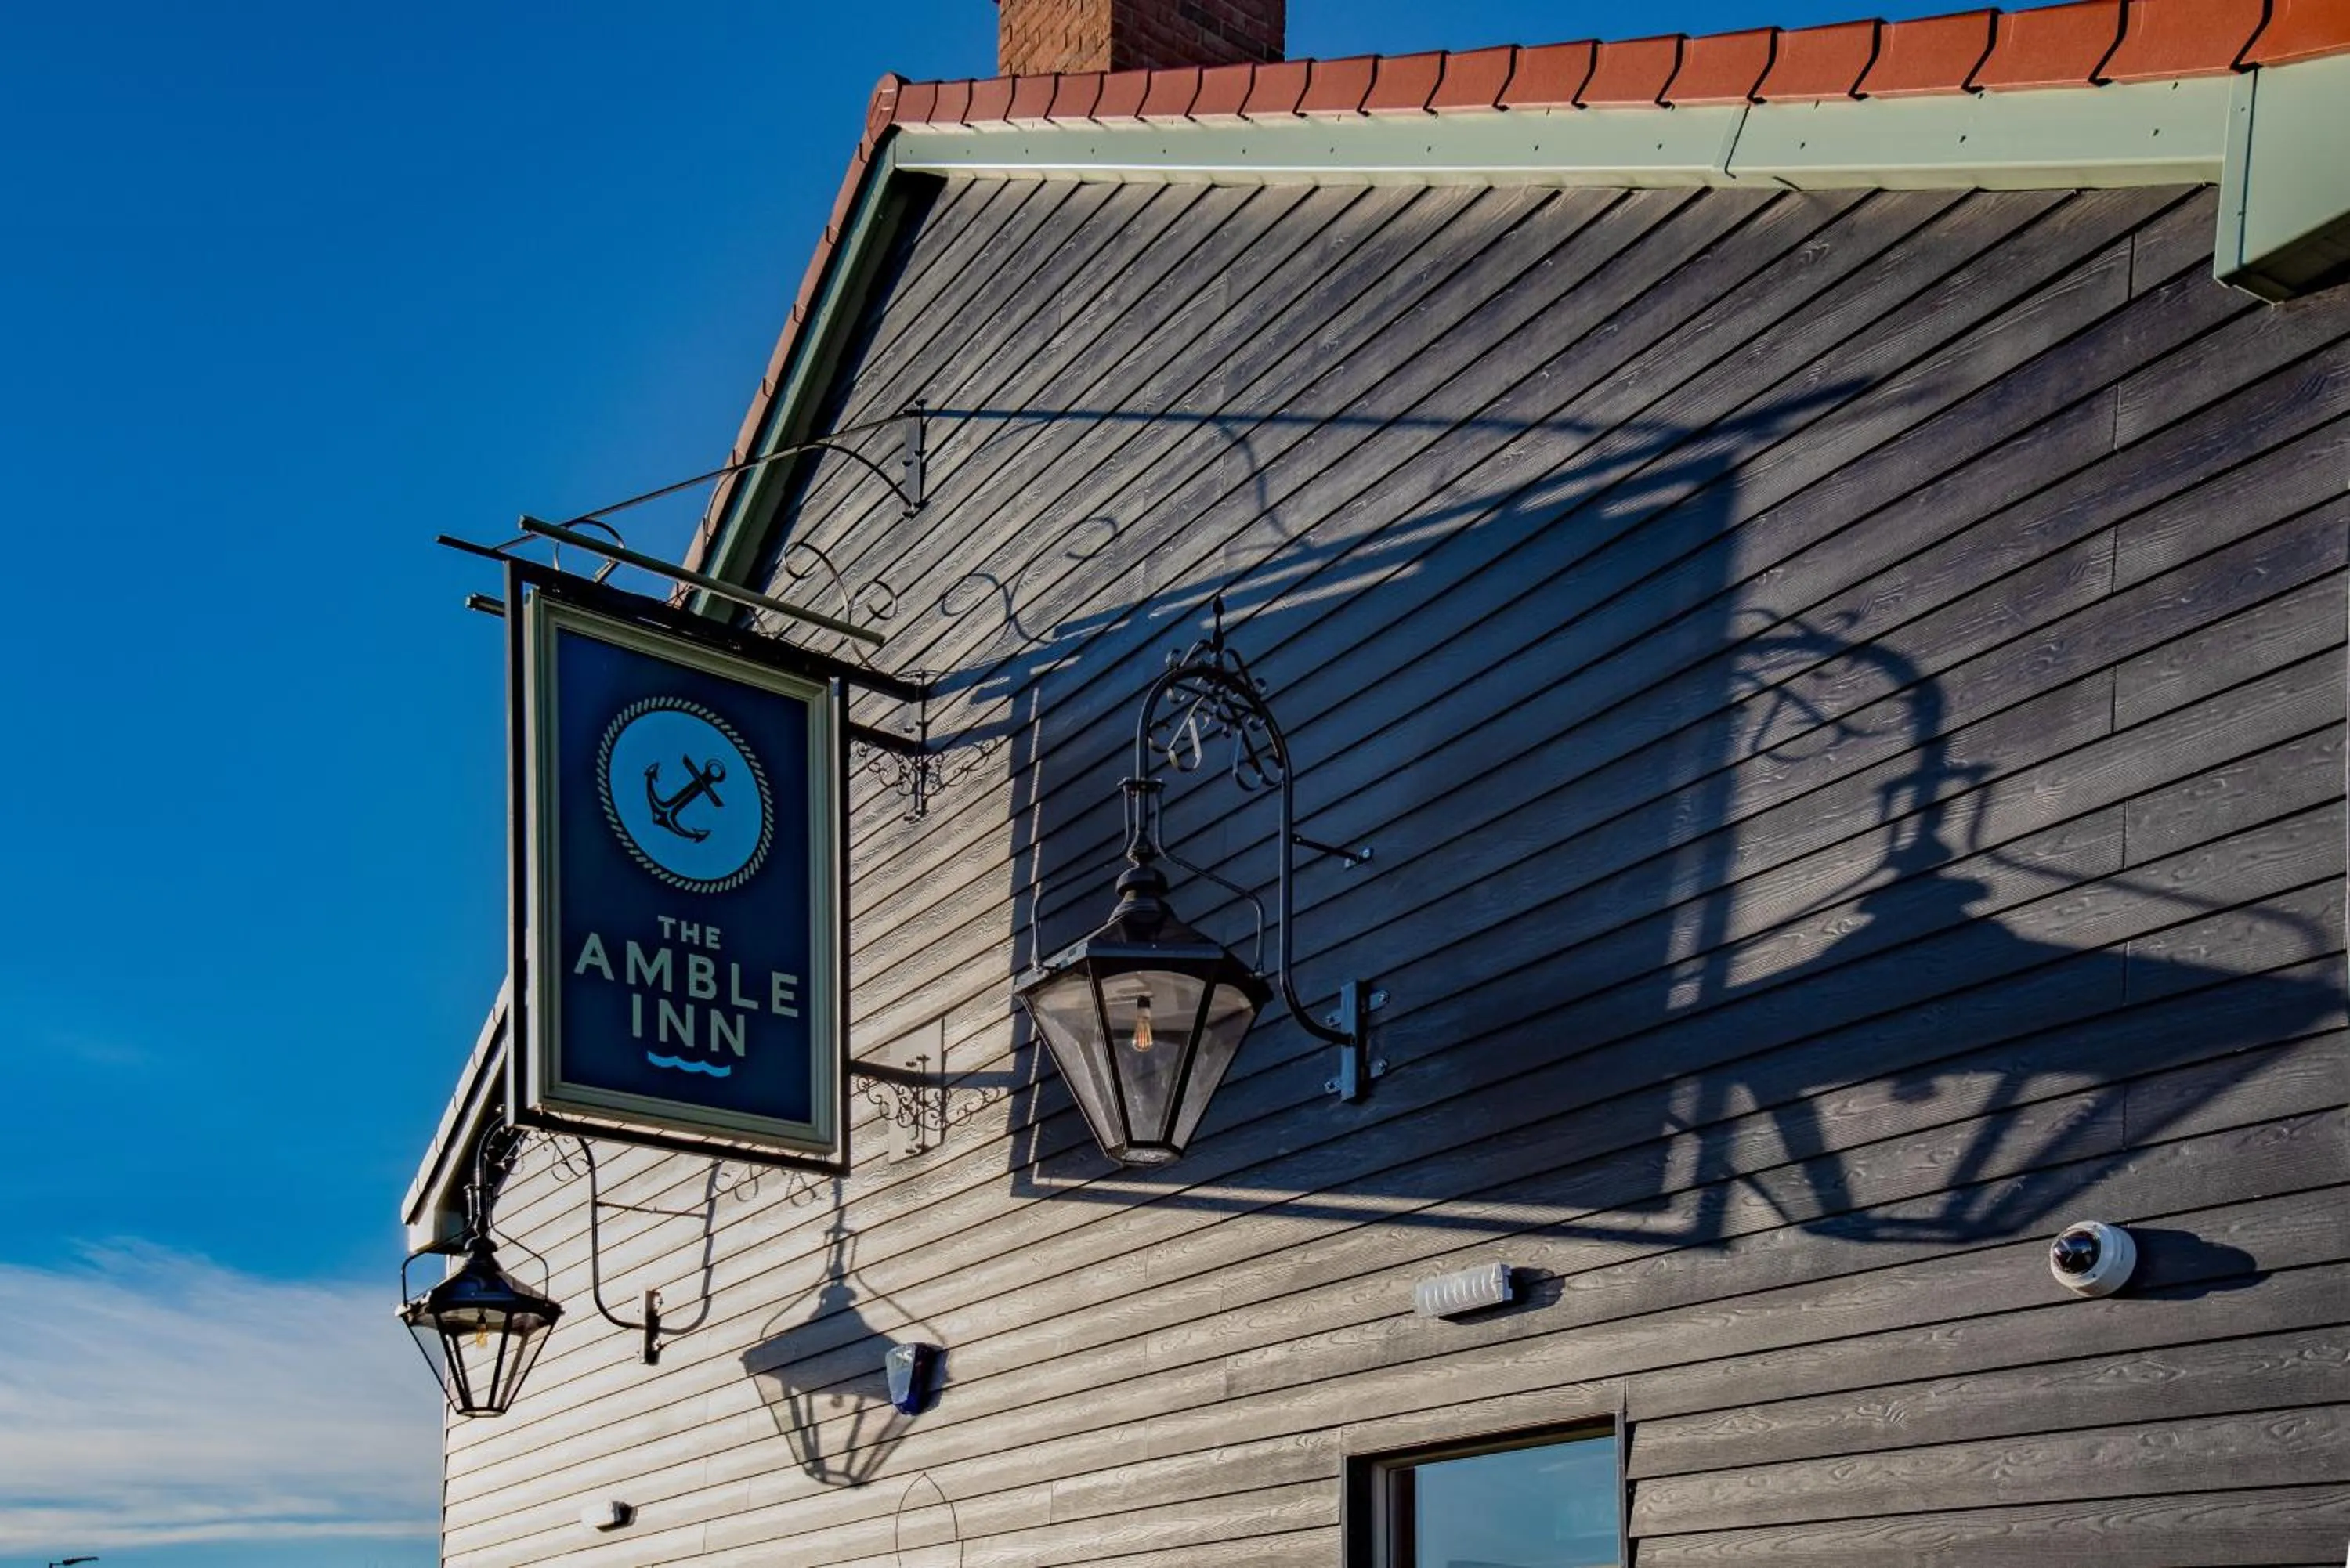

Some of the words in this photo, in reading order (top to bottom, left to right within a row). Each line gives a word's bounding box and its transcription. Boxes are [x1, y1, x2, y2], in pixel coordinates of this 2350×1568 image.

[657, 915, 721, 950] THE
[574, 932, 798, 1017] AMBLE
[632, 993, 745, 1057] INN
